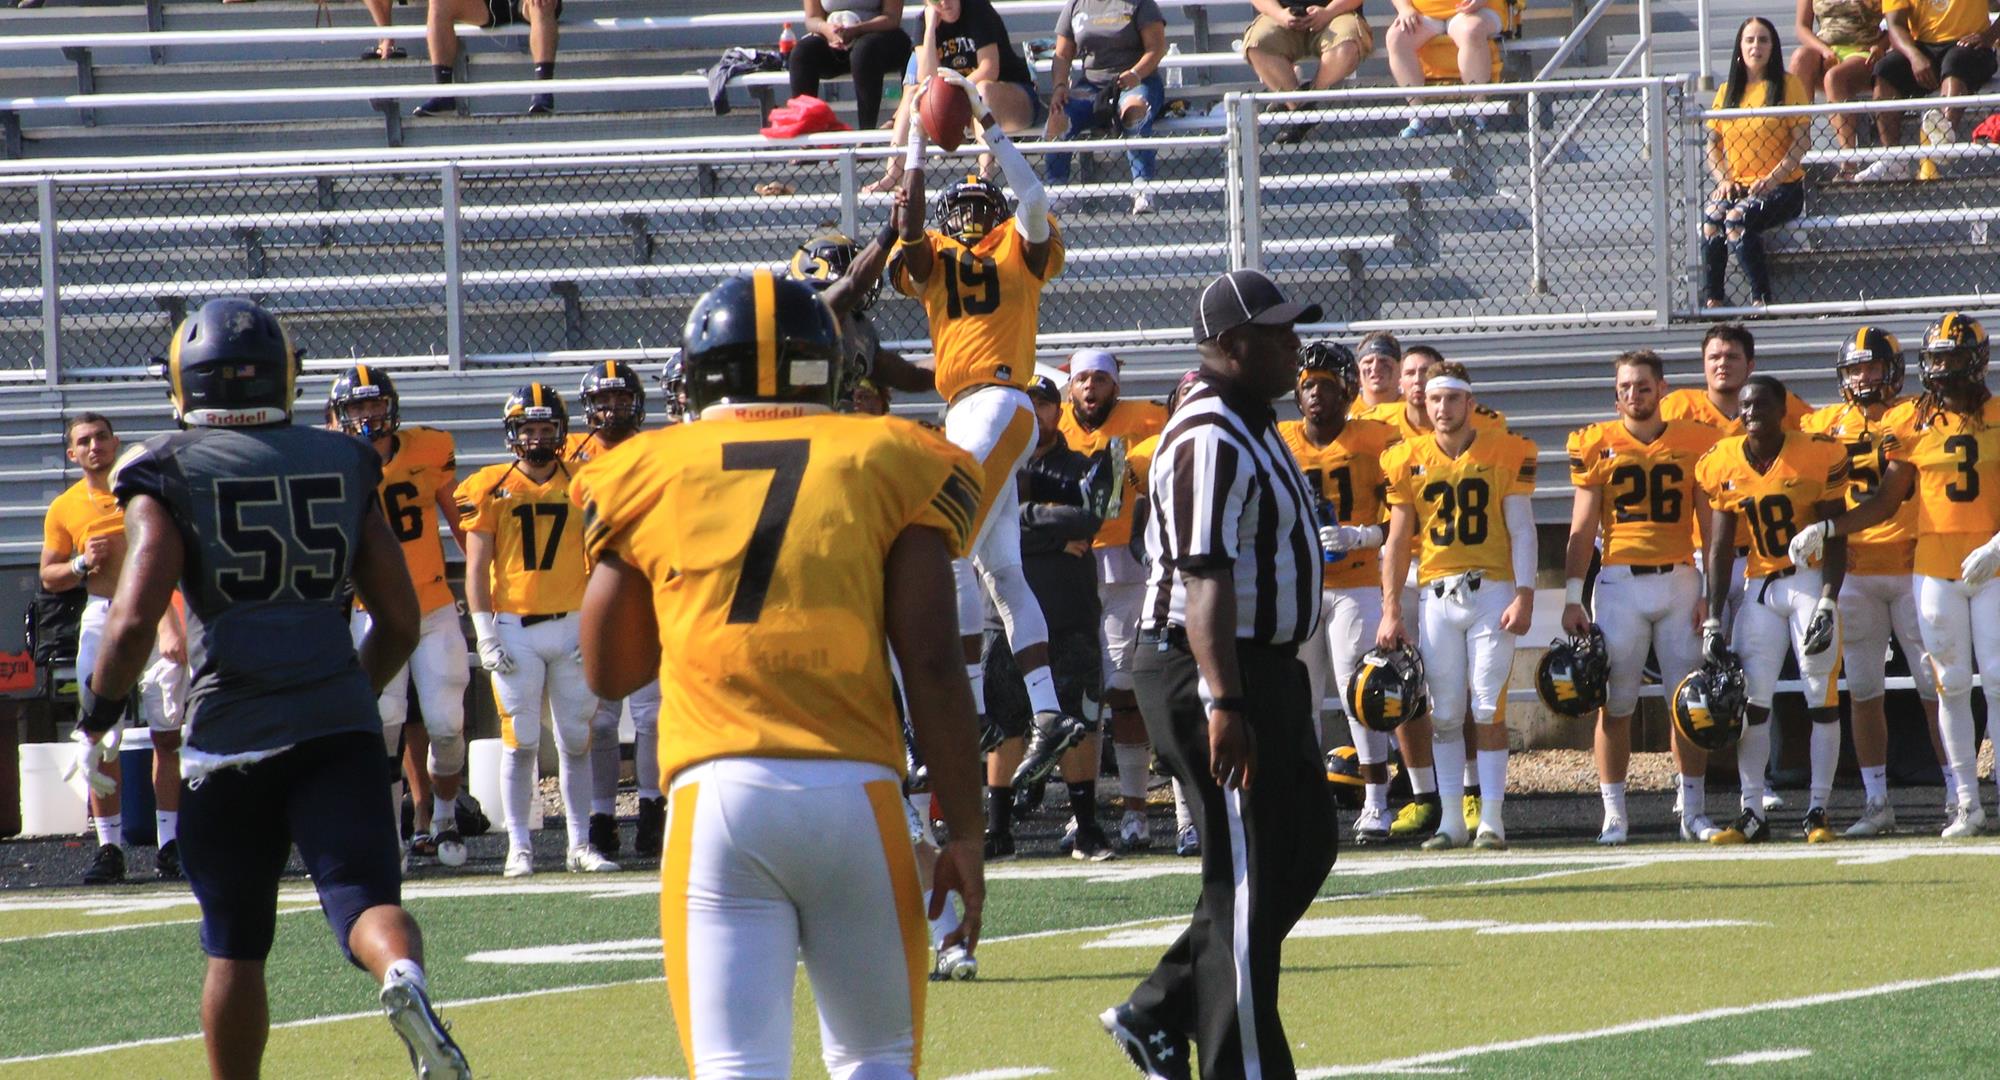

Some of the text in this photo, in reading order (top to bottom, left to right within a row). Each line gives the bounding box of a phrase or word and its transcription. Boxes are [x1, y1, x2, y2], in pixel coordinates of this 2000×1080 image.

[938, 247, 1000, 319] 19
[206, 411, 268, 425] Riddell
[735, 407, 804, 419] Riddell
[1611, 463, 1683, 523] 26
[1944, 434, 1980, 502] 3
[213, 473, 348, 603] 55
[512, 503, 568, 571] 17
[722, 438, 811, 625] 7
[1423, 478, 1489, 546] 38
[1738, 494, 1797, 557] 18
